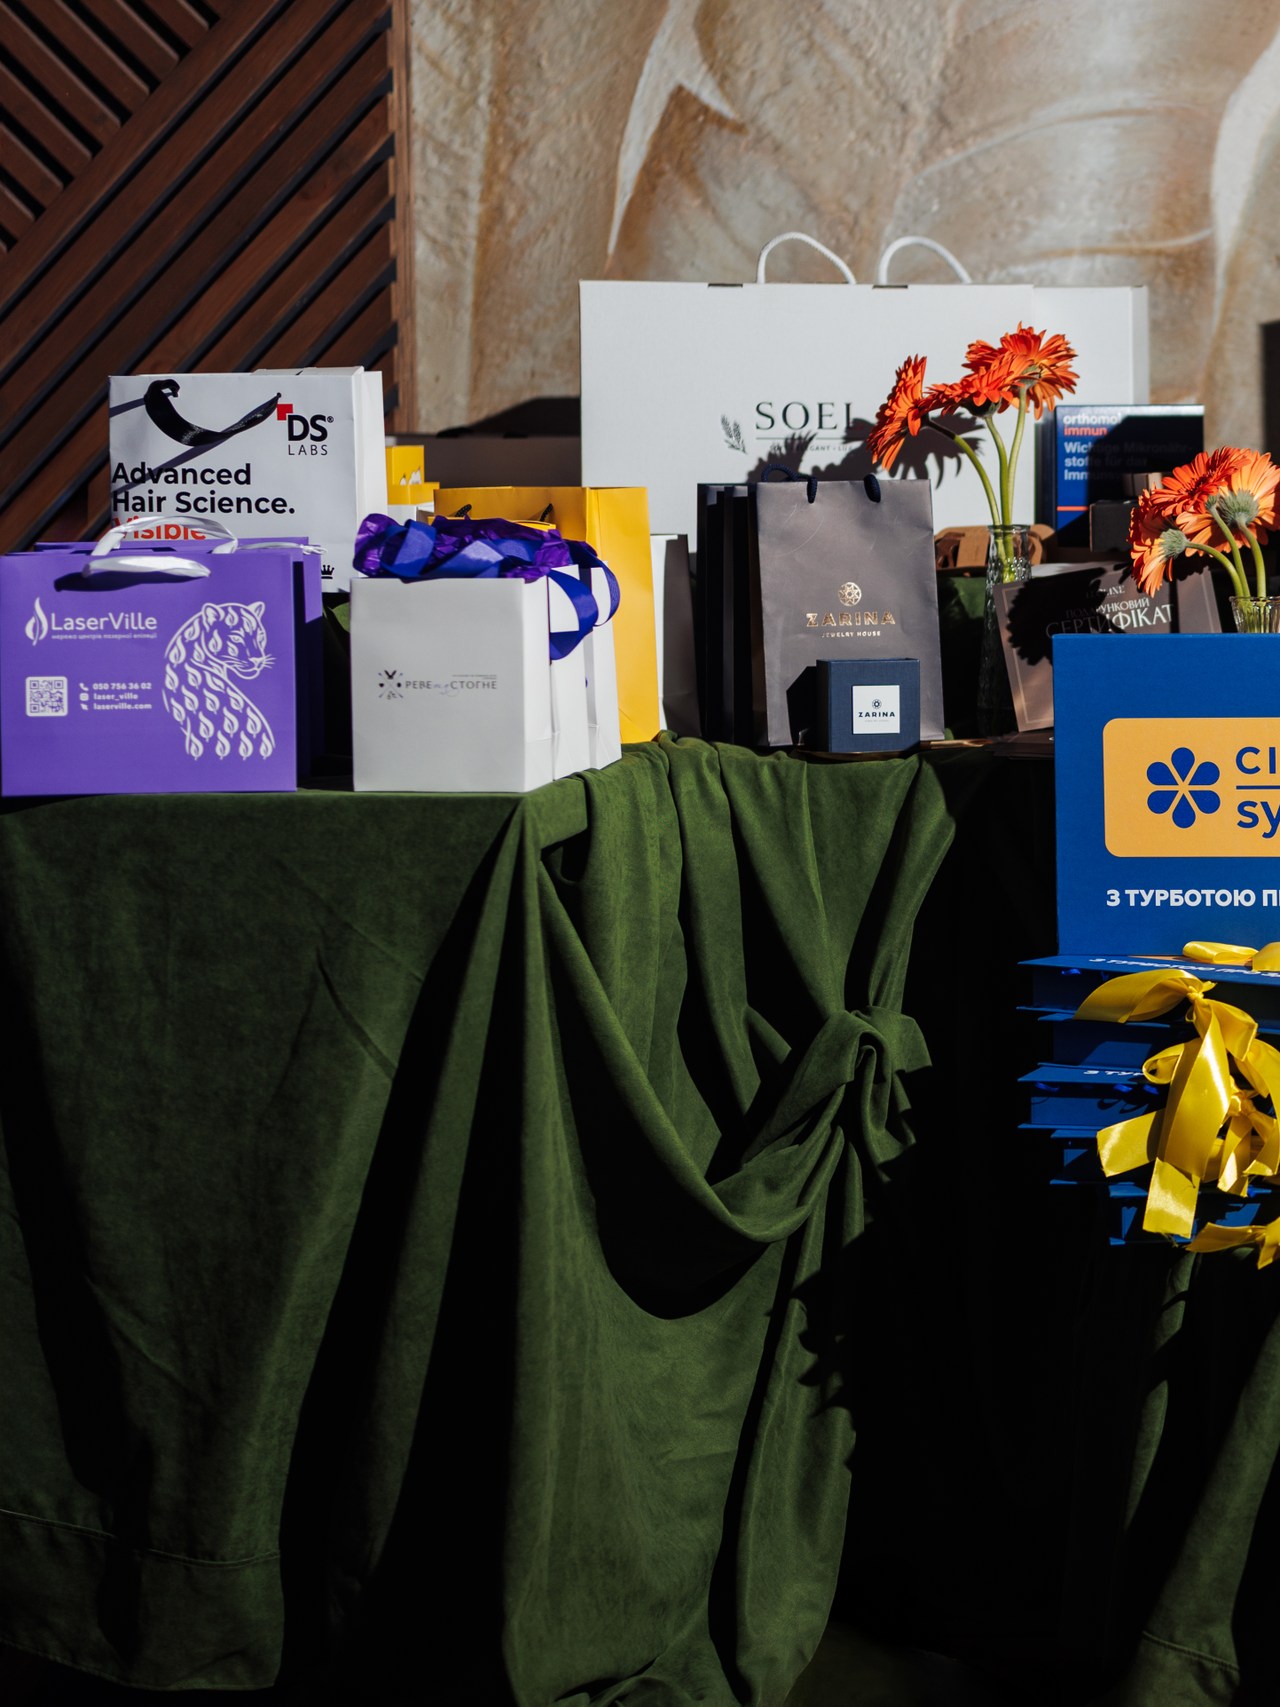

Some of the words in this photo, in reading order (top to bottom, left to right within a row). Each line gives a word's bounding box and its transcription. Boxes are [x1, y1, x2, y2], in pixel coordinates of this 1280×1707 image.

[1064, 426, 1108, 436] immun
[287, 445, 329, 456] LABS
[112, 462, 251, 486] Advanced
[112, 490, 167, 513] Hair
[175, 490, 295, 514] Science.
[51, 612, 158, 630] LaserVille
[806, 611, 896, 627] ZARINA
[1106, 889, 1121, 907] З
[1125, 889, 1256, 907] ТУРБОТОЮ
